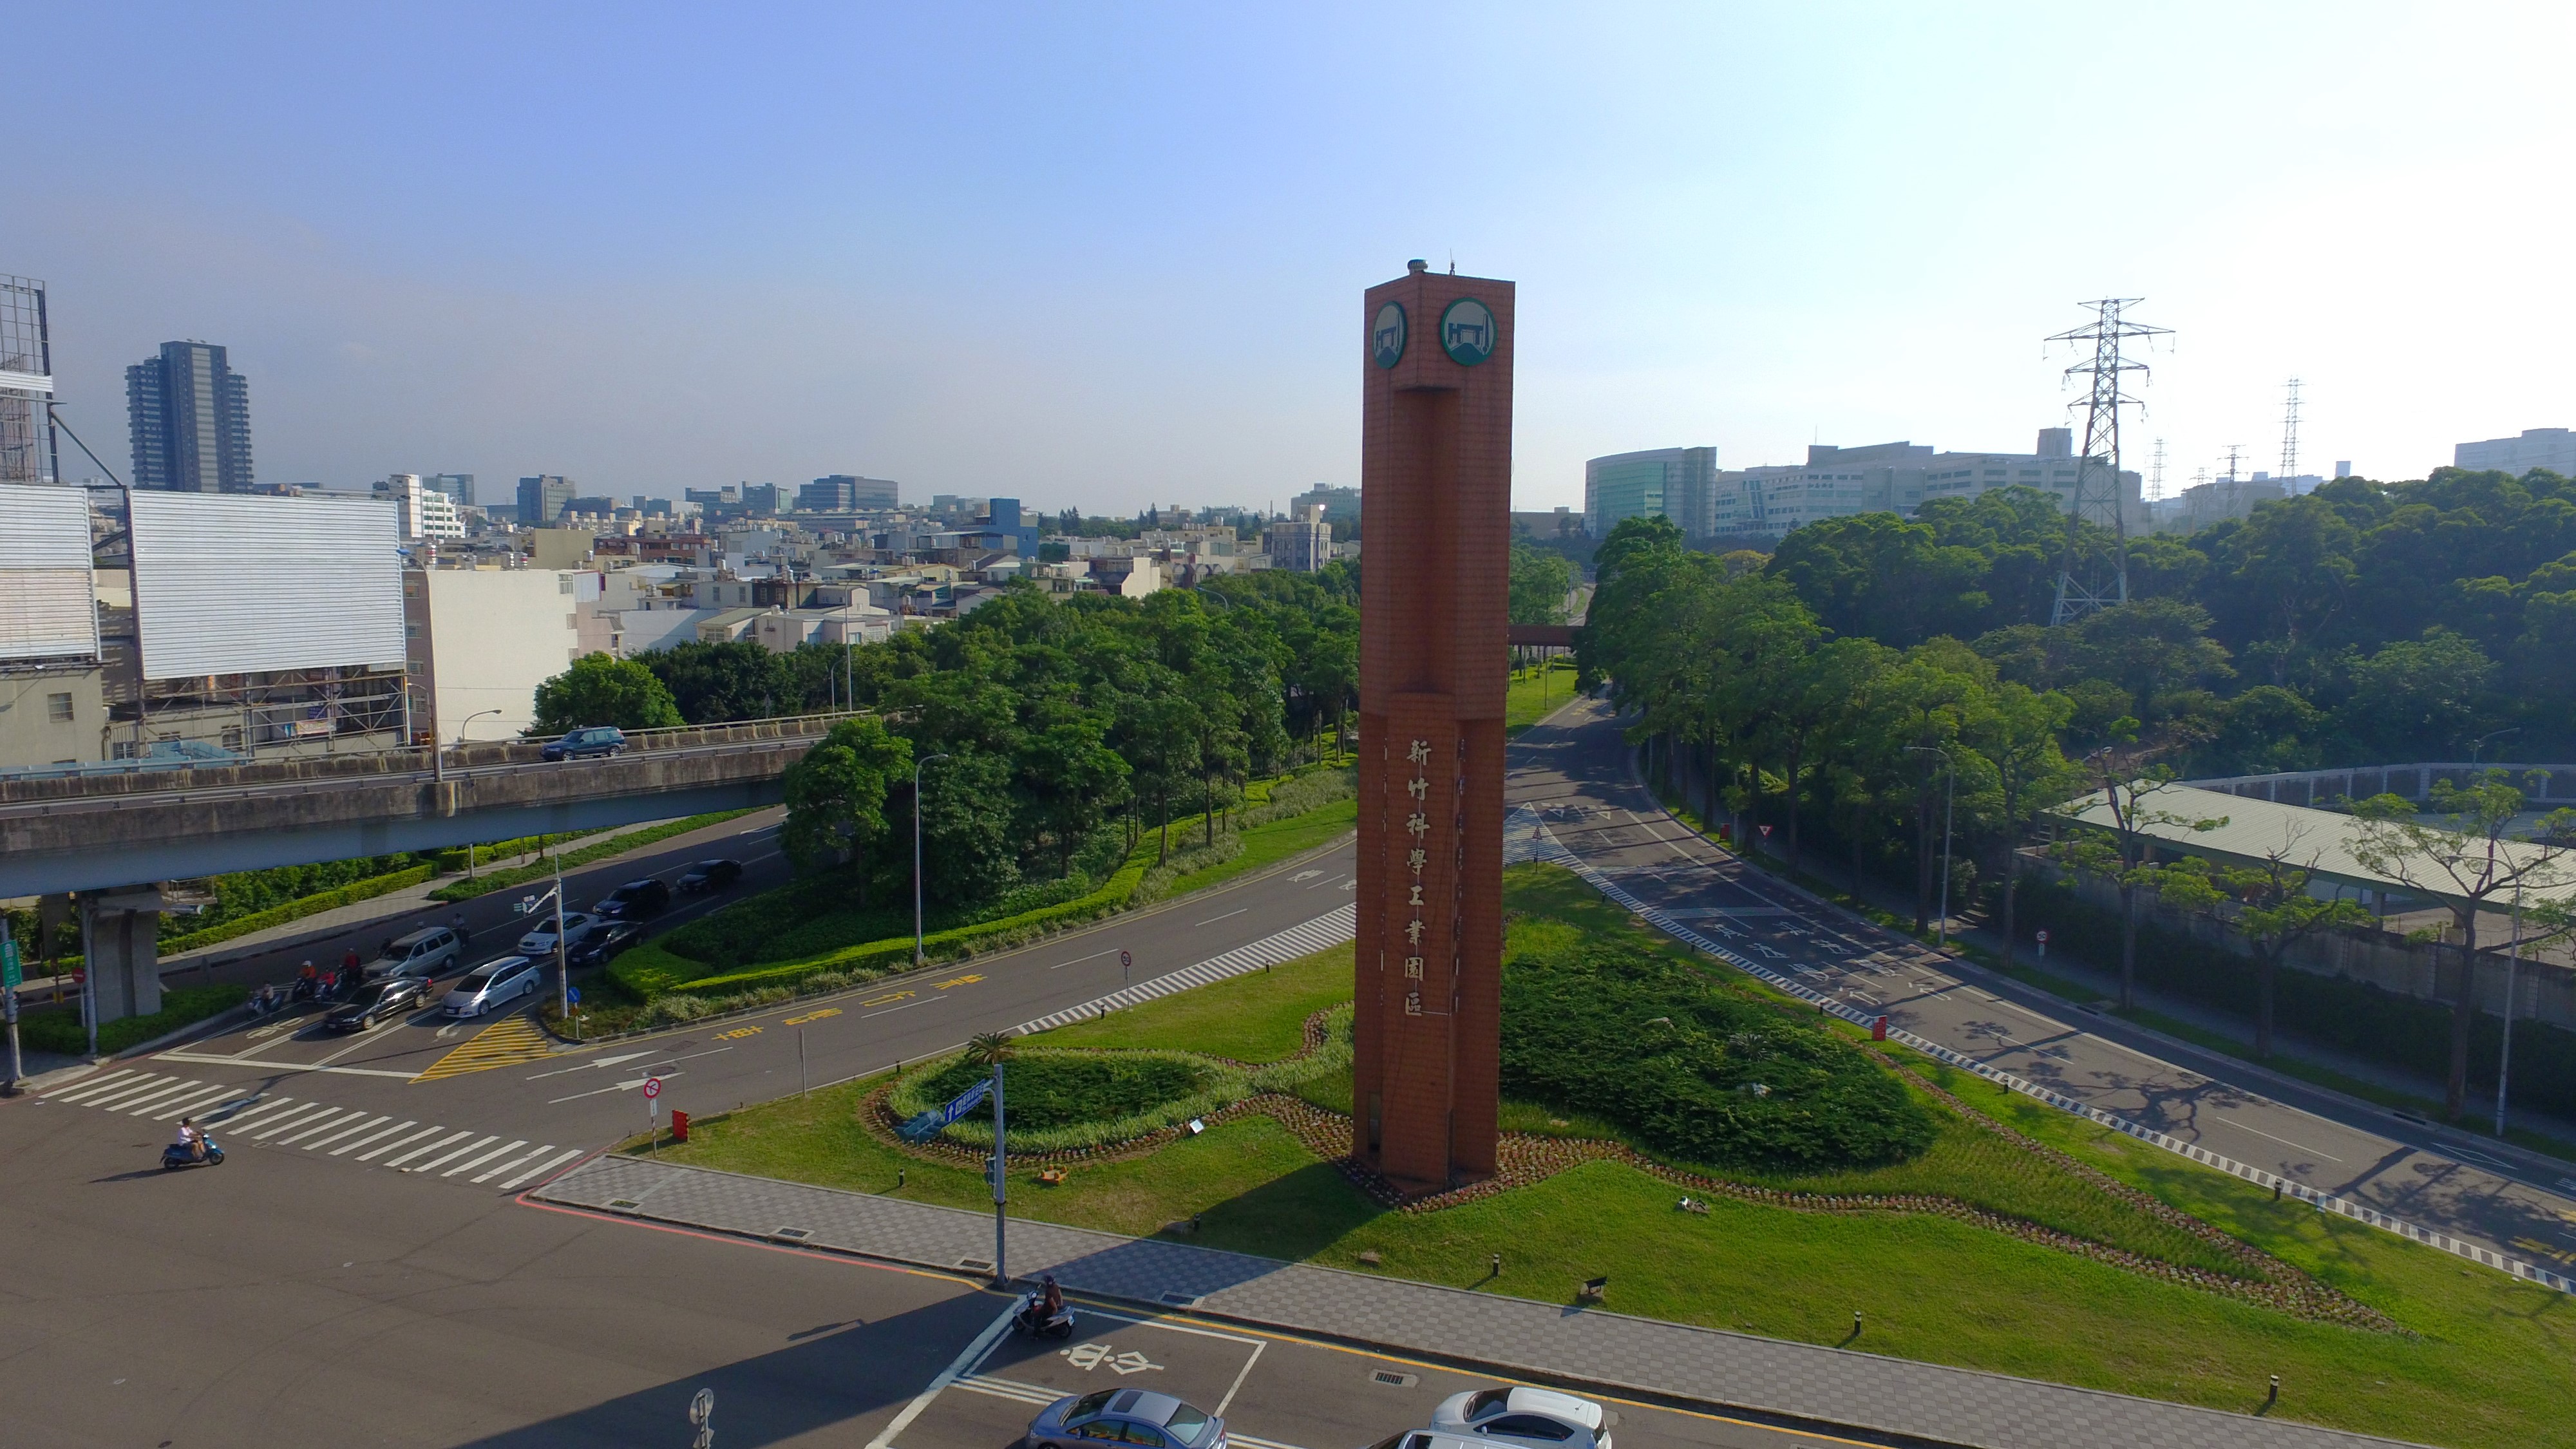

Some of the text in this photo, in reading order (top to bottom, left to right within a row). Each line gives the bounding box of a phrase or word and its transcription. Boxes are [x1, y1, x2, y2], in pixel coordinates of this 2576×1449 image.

[1405, 739, 1432, 1017] 新竹科學工業園區
[712, 974, 987, 1040] 禁行機車
